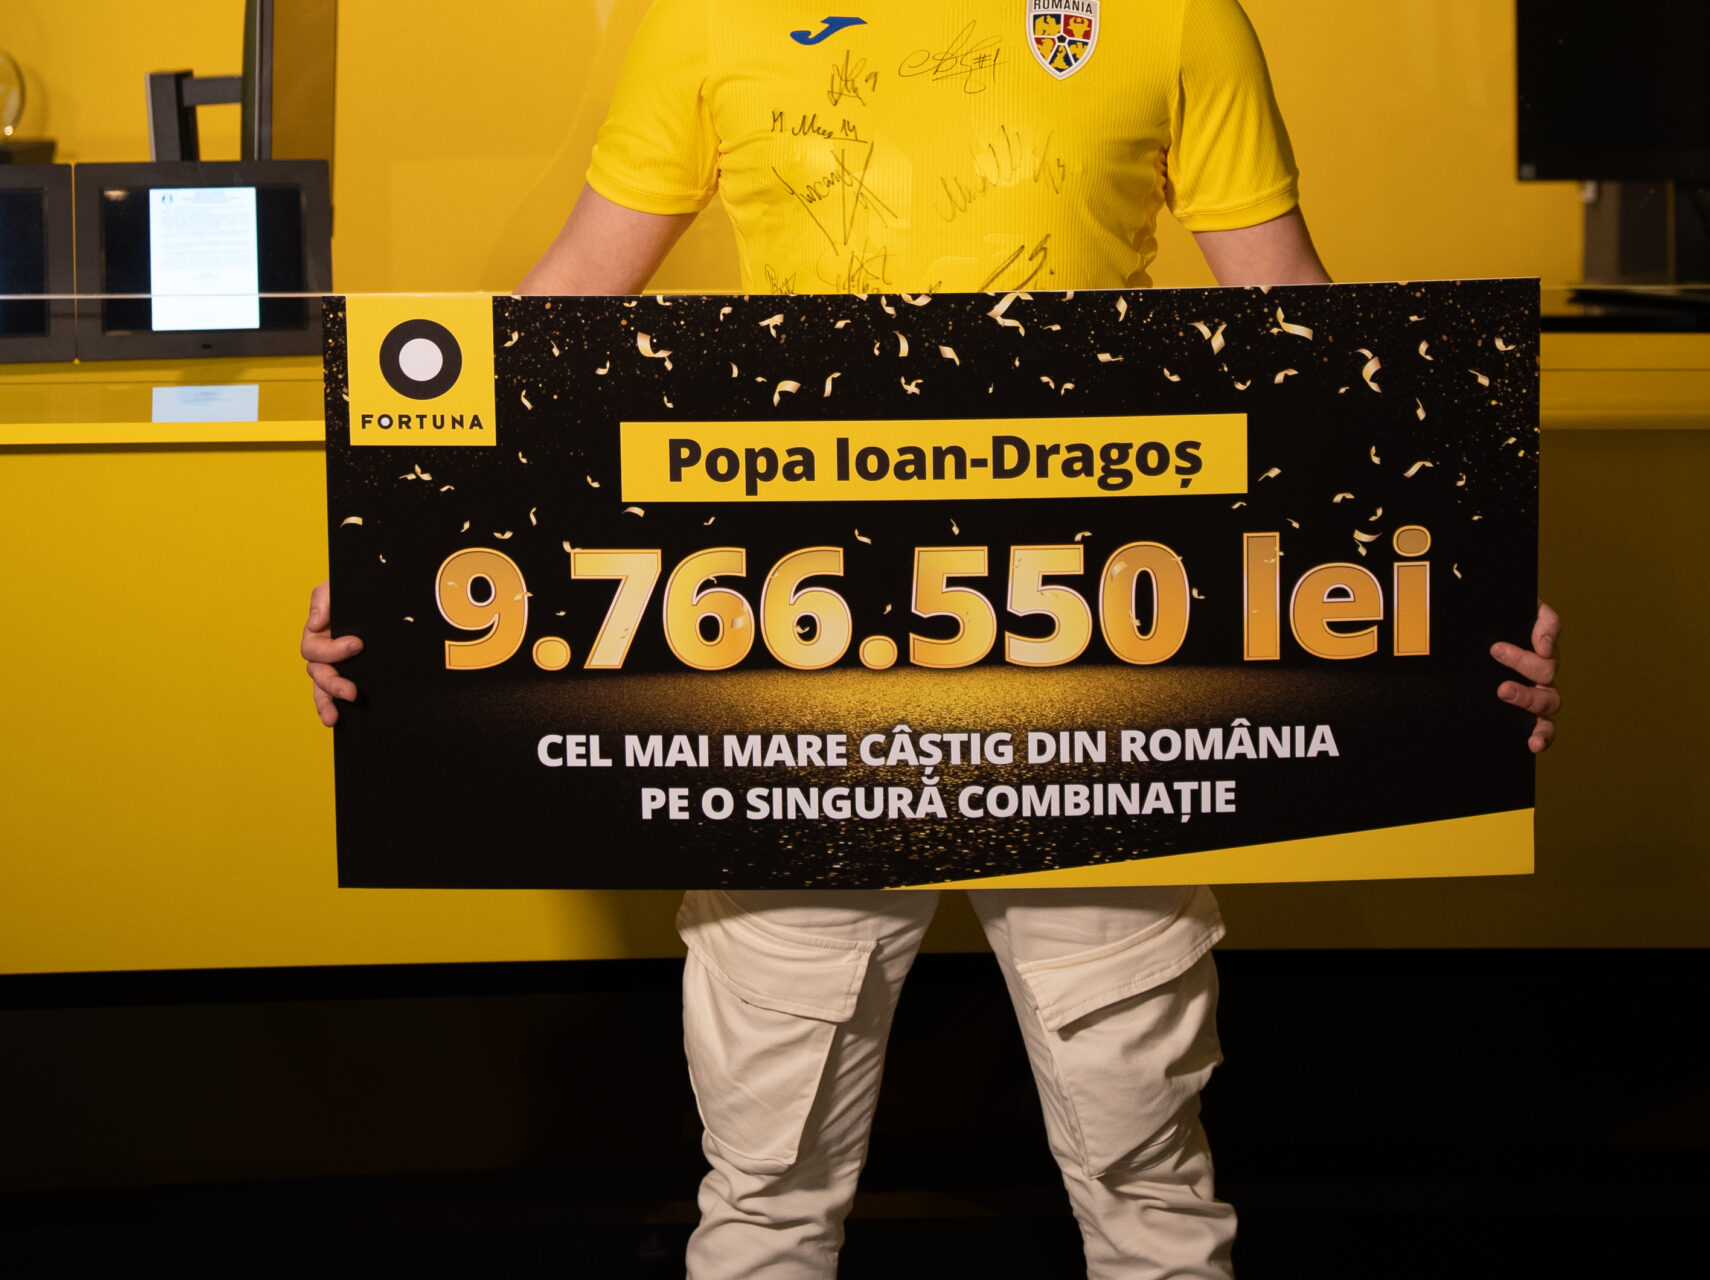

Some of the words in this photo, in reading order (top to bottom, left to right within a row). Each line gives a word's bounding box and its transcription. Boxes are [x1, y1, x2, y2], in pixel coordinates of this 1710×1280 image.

[361, 414, 484, 430] FORTUNA
[668, 437, 816, 496] Popa
[837, 435, 1203, 492] Ioan-Dragoș
[435, 542, 1191, 671] 9.766.550
[1243, 525, 1432, 661] lei
[537, 734, 612, 767] CEL
[625, 734, 710, 766] MAI
[723, 734, 848, 766] MARE
[859, 725, 1014, 775] CÂȘTIG
[1027, 732, 1107, 764] DIN
[1121, 718, 1340, 762] ROMÂNIA
[641, 787, 690, 820] PE
[702, 787, 735, 820] O
[746, 776, 947, 820] SINGURĂ
[958, 780, 1237, 823] COMBINAȚIE
